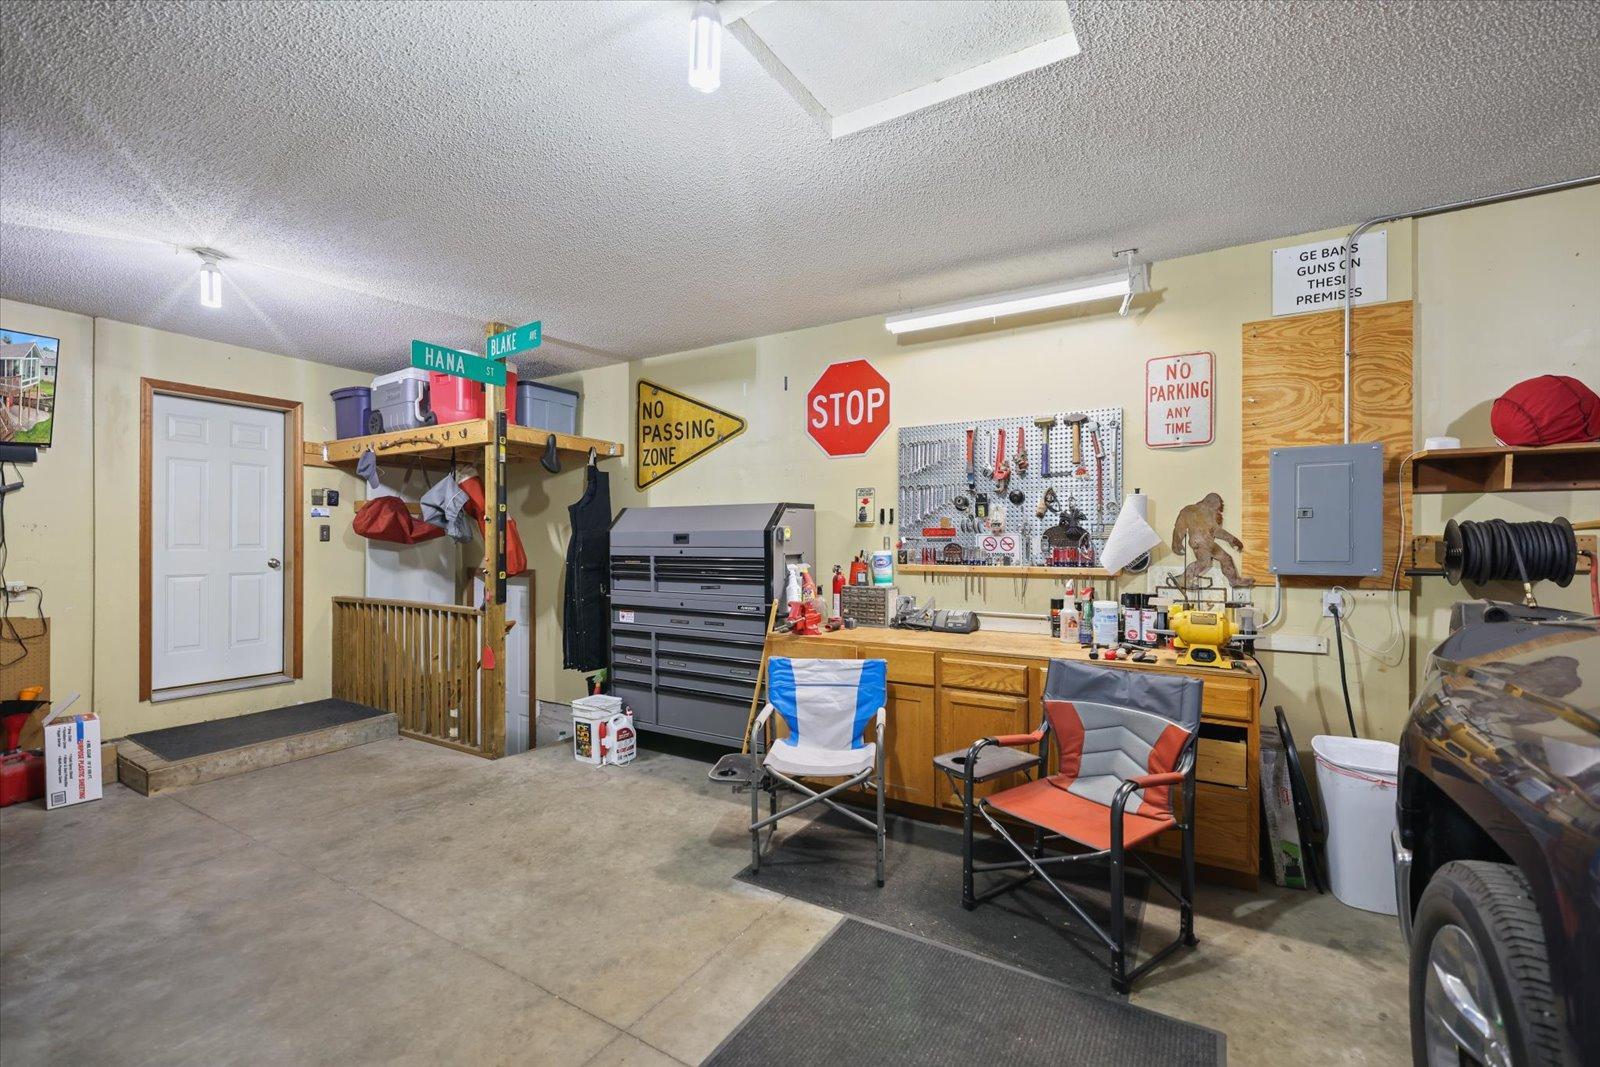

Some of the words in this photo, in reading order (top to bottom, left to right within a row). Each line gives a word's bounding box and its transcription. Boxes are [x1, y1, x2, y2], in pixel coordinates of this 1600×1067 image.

[1299, 250, 1317, 262] GE
[1321, 243, 1359, 259] BANS
[1297, 261, 1335, 277] GUNS
[1296, 287, 1363, 306] PREMISES
[490, 332, 517, 356] BLAKE
[528, 329, 538, 341] AVE
[425, 347, 465, 374] HANA
[485, 366, 494, 377] ST
[1166, 362, 1191, 381] NO
[1149, 380, 1209, 403] PARKING
[642, 400, 664, 420] NO
[811, 387, 885, 429] STOP
[1166, 406, 1191, 419] ANY
[642, 418, 715, 443] PASSING
[1165, 421, 1192, 435] TIME
[642, 446, 677, 467] ZONE
